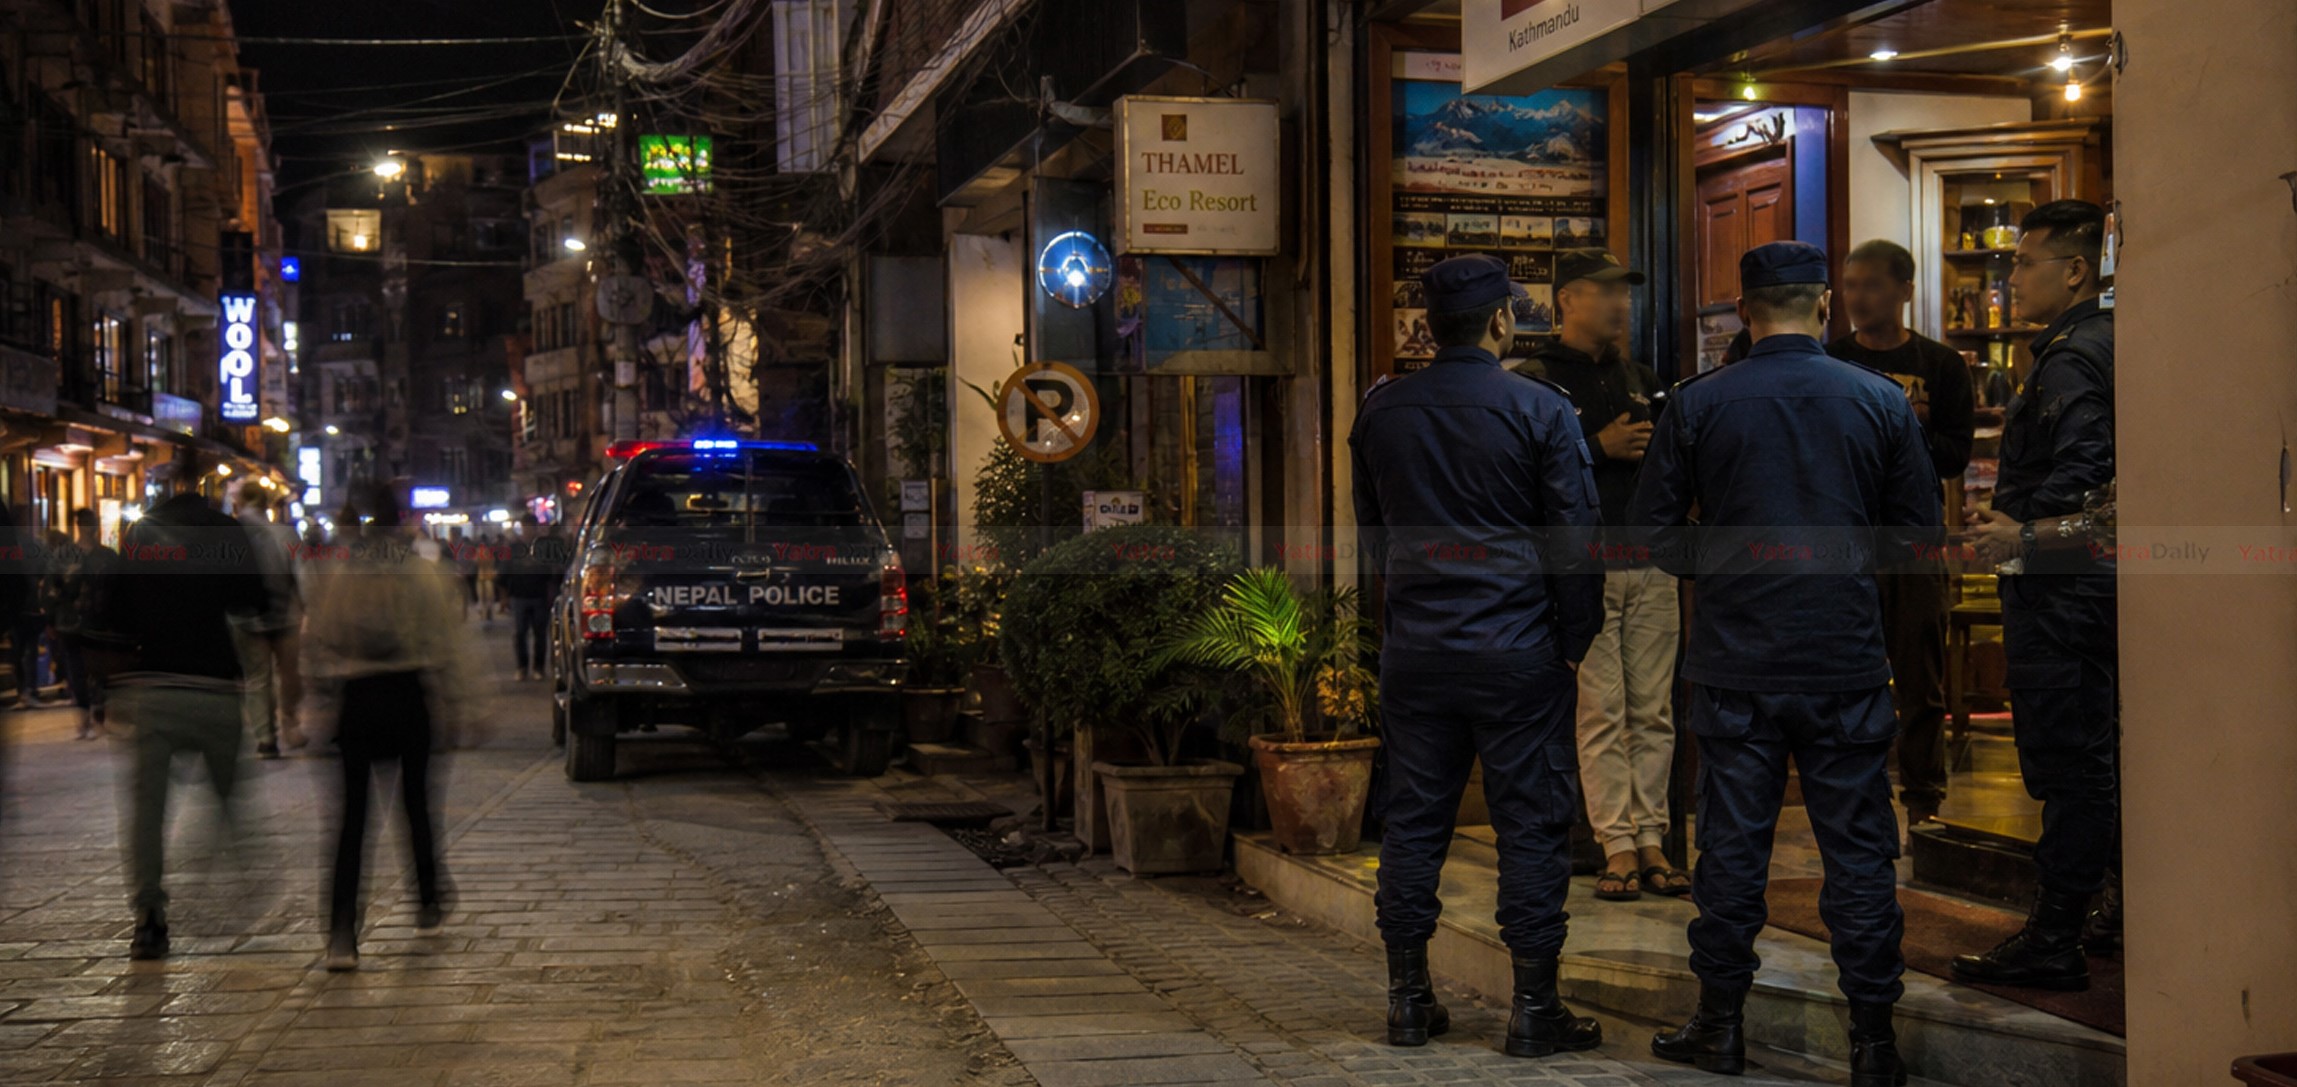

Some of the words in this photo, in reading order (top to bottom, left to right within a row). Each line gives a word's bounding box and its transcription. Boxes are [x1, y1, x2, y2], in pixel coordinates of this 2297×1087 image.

[1508, 3, 1580, 52] Kathmandu
[1141, 152, 1244, 175] THAMEL
[1143, 189, 1182, 211] Eco
[1189, 189, 1258, 212] Resort
[1024, 378, 1074, 442] P
[826, 556, 871, 566] HILUX
[655, 586, 738, 606] NEPAL
[749, 586, 840, 606] POLICE
